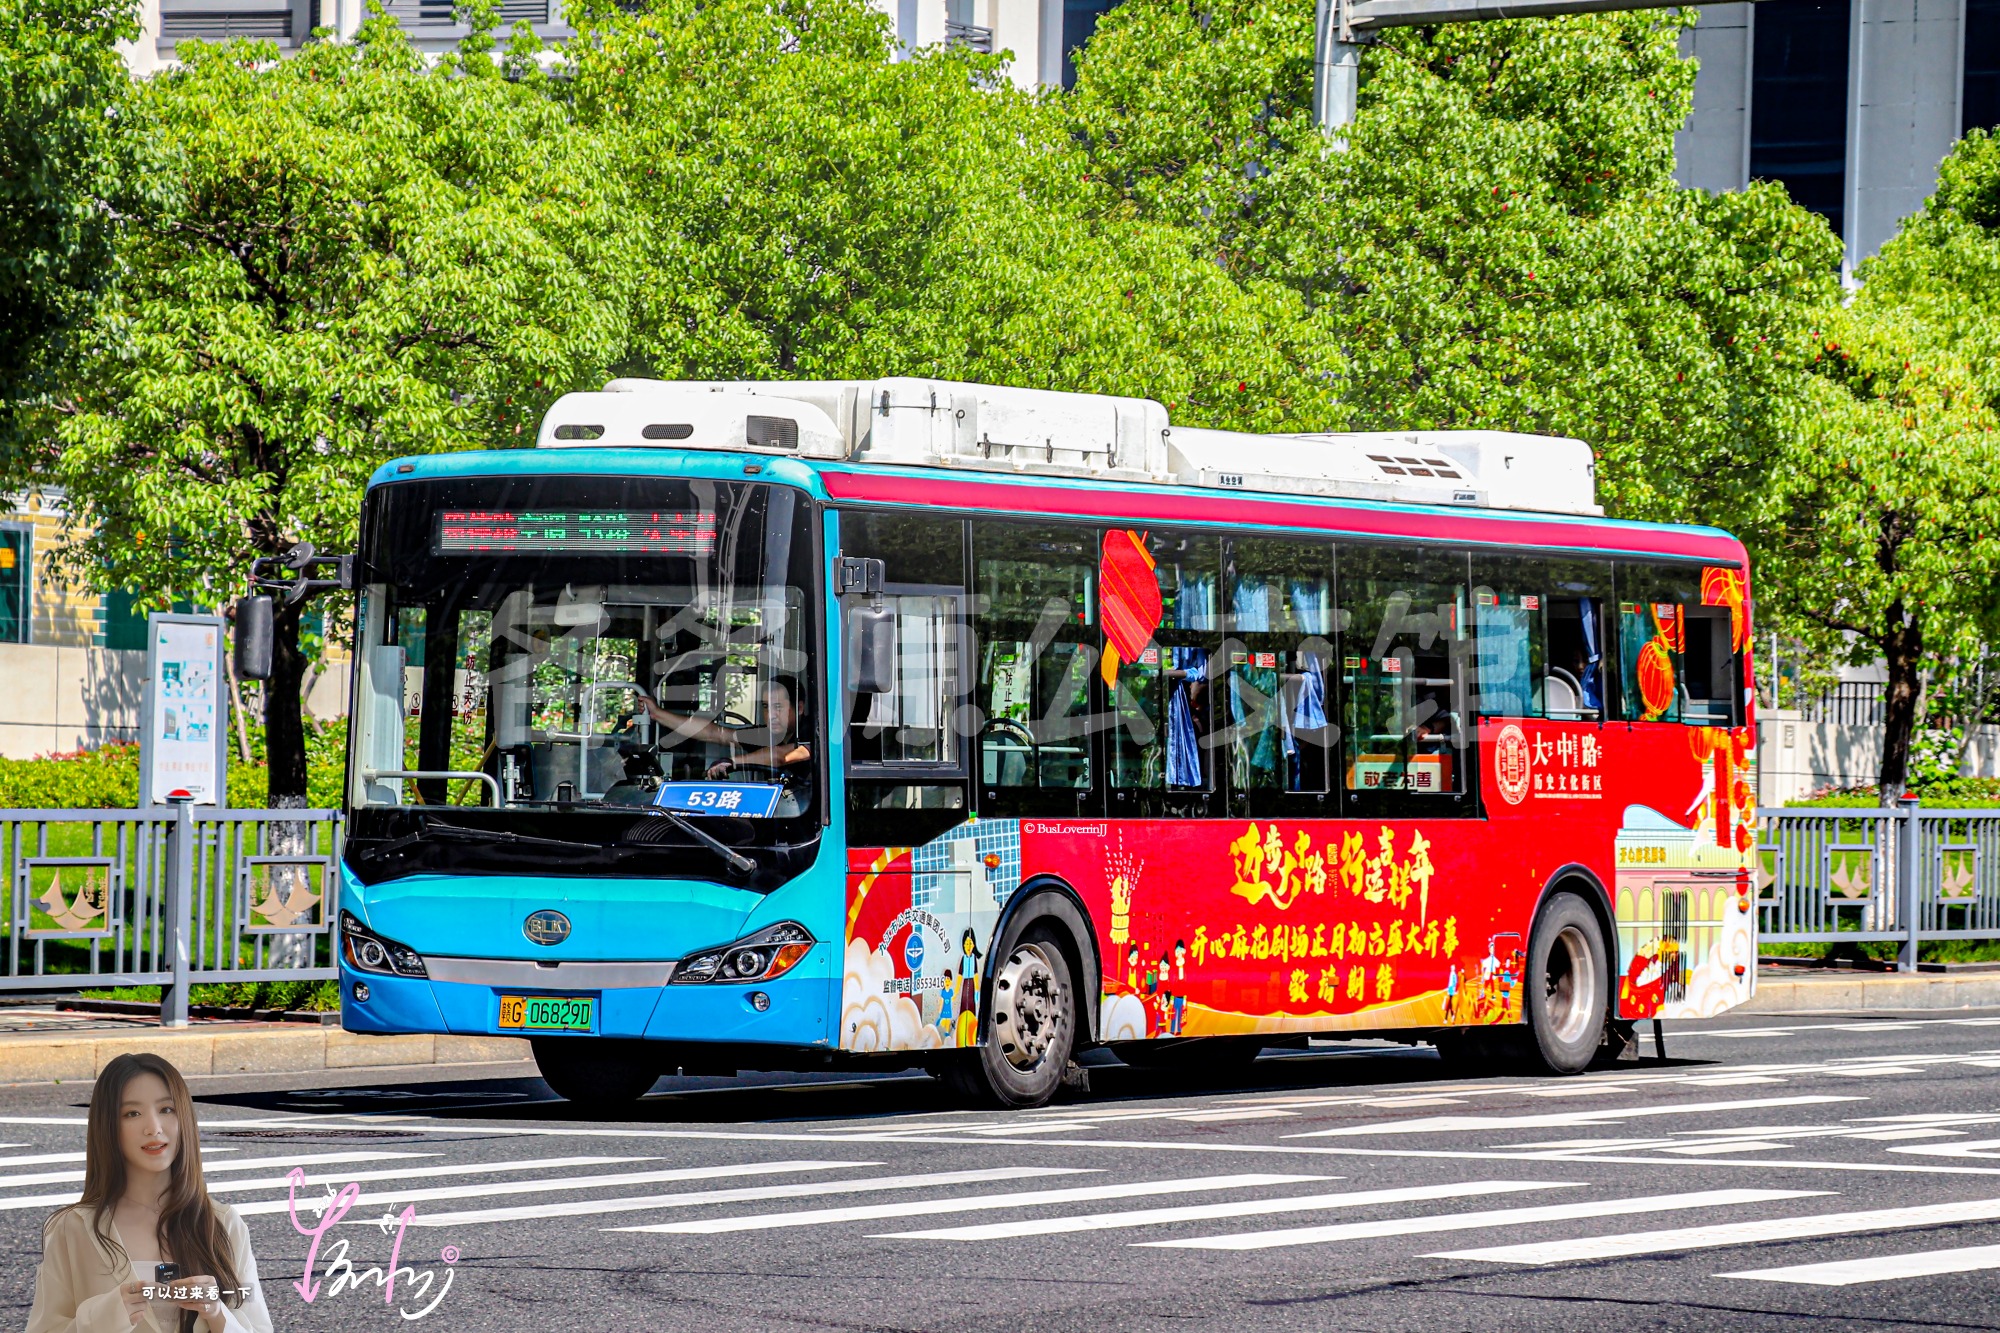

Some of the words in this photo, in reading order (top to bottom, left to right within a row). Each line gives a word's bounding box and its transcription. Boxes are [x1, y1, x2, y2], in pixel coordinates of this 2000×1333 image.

[1532, 731, 1598, 768] 大中路
[1534, 773, 1602, 791] 历史文化街区
[687, 790, 742, 809] 53路
[530, 919, 563, 934] BLK
[1288, 963, 1395, 1004] 敬请期待
